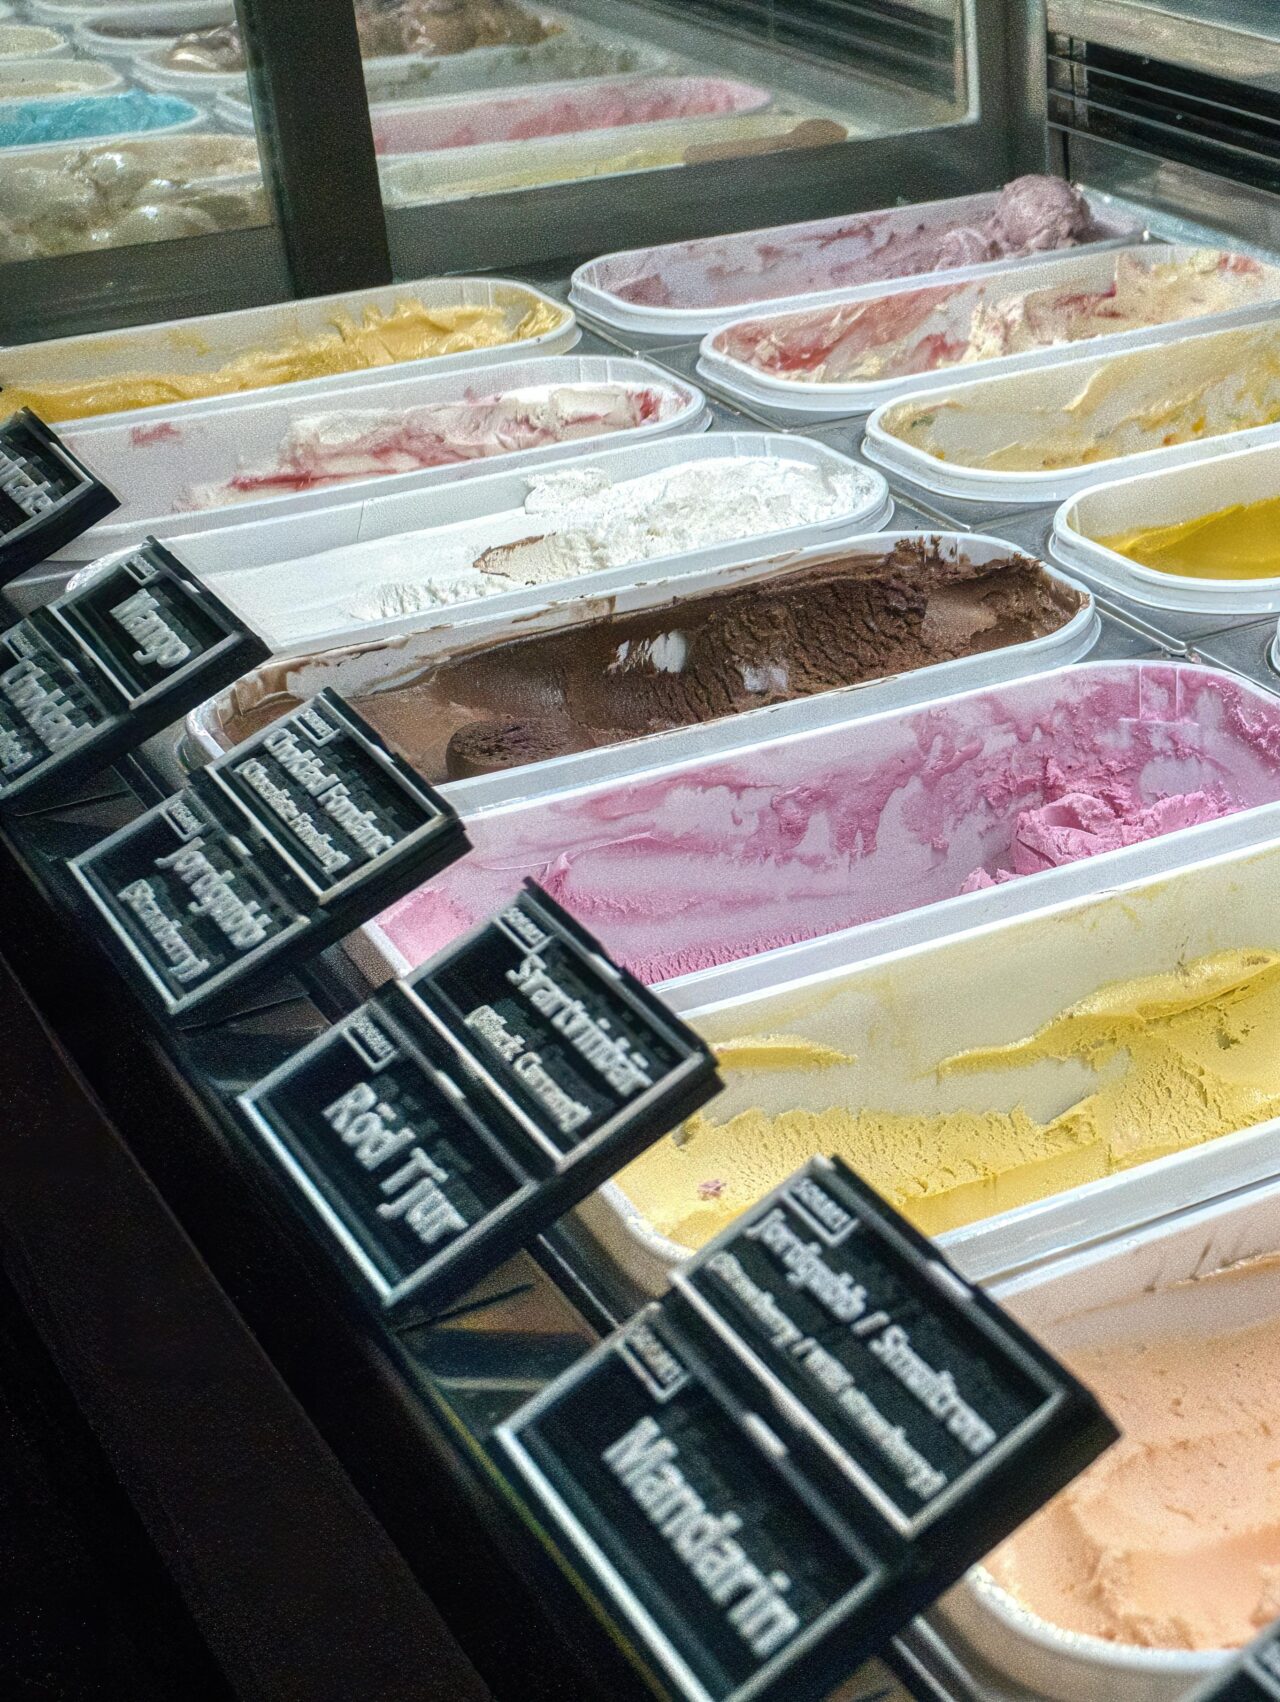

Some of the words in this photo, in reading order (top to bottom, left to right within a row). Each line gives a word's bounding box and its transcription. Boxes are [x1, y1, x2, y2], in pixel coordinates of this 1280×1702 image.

[112, 589, 193, 665] Mango
[157, 836, 275, 946] Jordgubb
[508, 949, 652, 1093] Svartvinbär
[325, 1083, 415, 1166] Röd
[378, 1147, 468, 1242] Tjur
[741, 1209, 866, 1318] Jordgubb
[871, 1326, 995, 1452] Smultron
[605, 1418, 799, 1653] Mandarin
